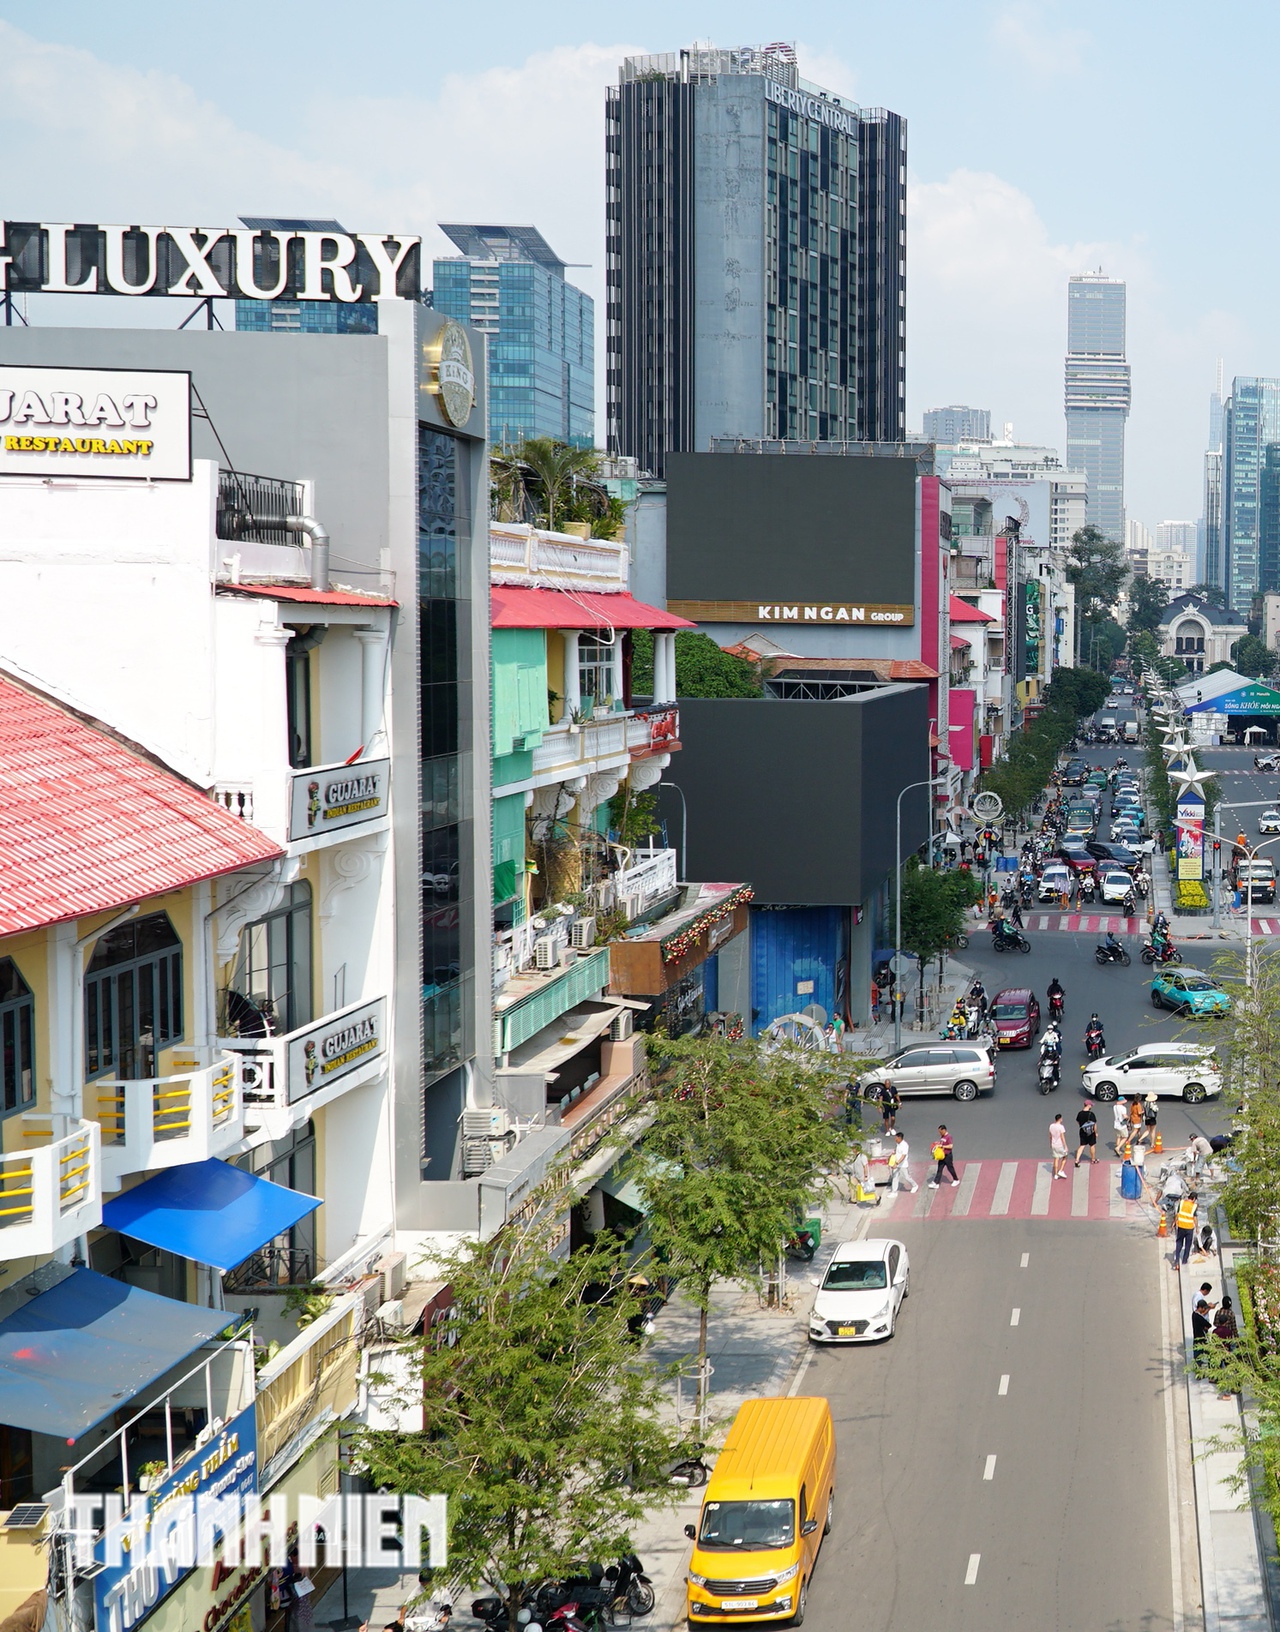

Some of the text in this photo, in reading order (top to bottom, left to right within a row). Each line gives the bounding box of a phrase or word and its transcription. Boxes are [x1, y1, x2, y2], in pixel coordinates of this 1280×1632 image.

[41, 223, 421, 303] LUXURY
[5, 436, 154, 456] RESTAURANT
[758, 605, 904, 622] KIM NGAN GROUP
[328, 775, 381, 804] GUJARAT
[325, 797, 381, 819] INDIAN RESTAURANT
[325, 1015, 378, 1057] GUJARAT
